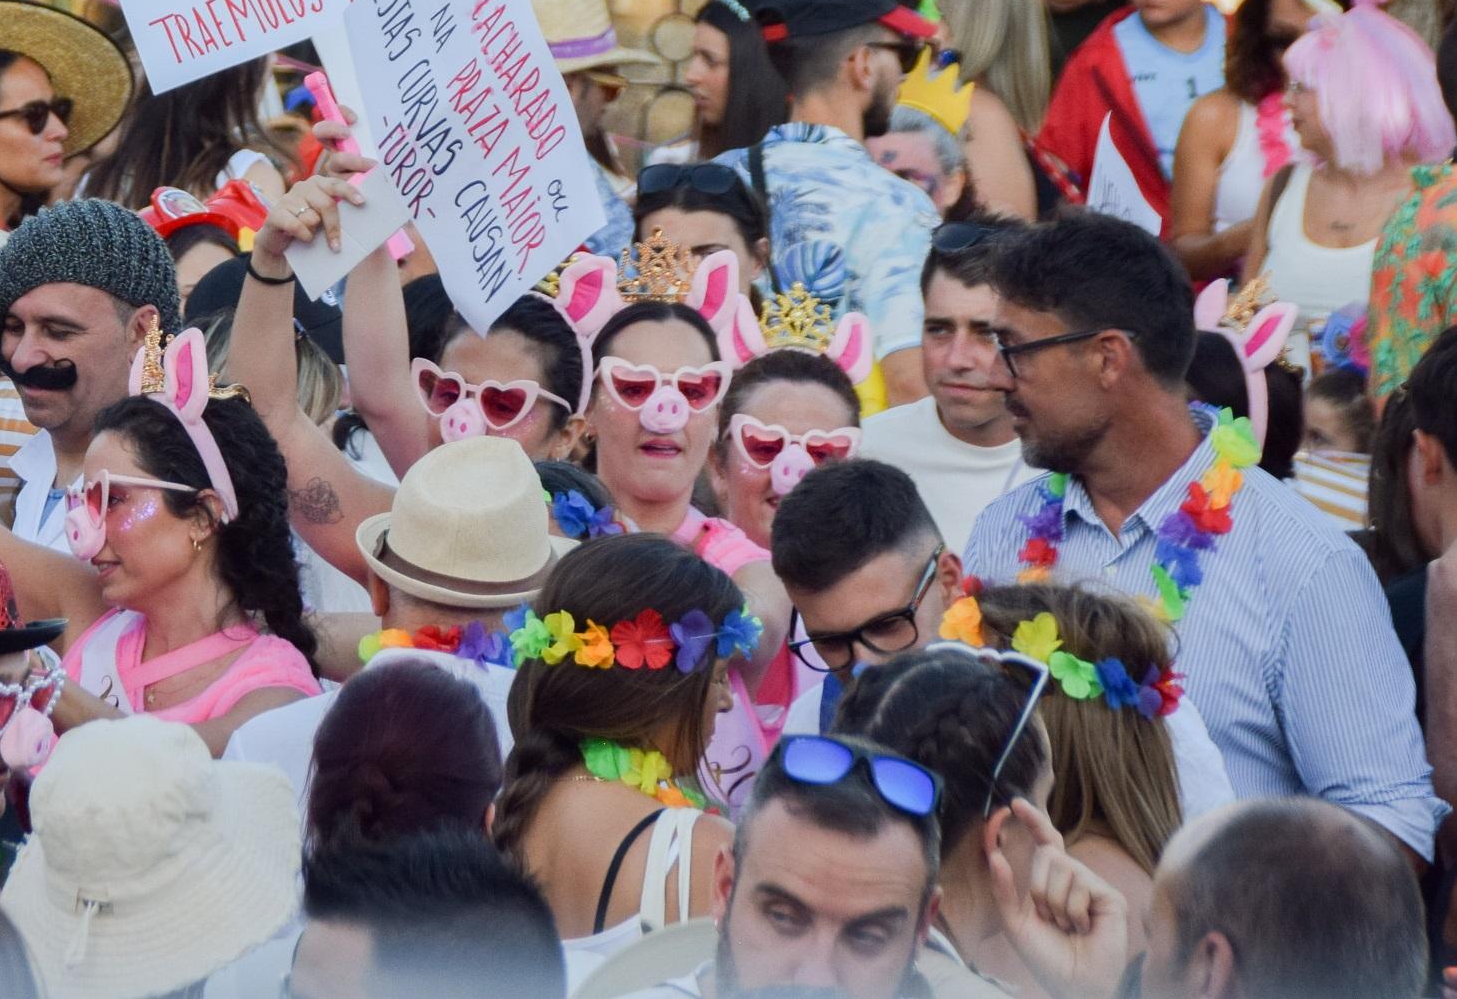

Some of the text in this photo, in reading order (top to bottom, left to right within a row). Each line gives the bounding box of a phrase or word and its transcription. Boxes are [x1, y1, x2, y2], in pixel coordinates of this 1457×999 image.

[397, 59, 464, 176] CURVAS
[455, 179, 513, 304] CAUSAN
[430, 2, 458, 54] NA
[446, 56, 510, 160] PRAZA
